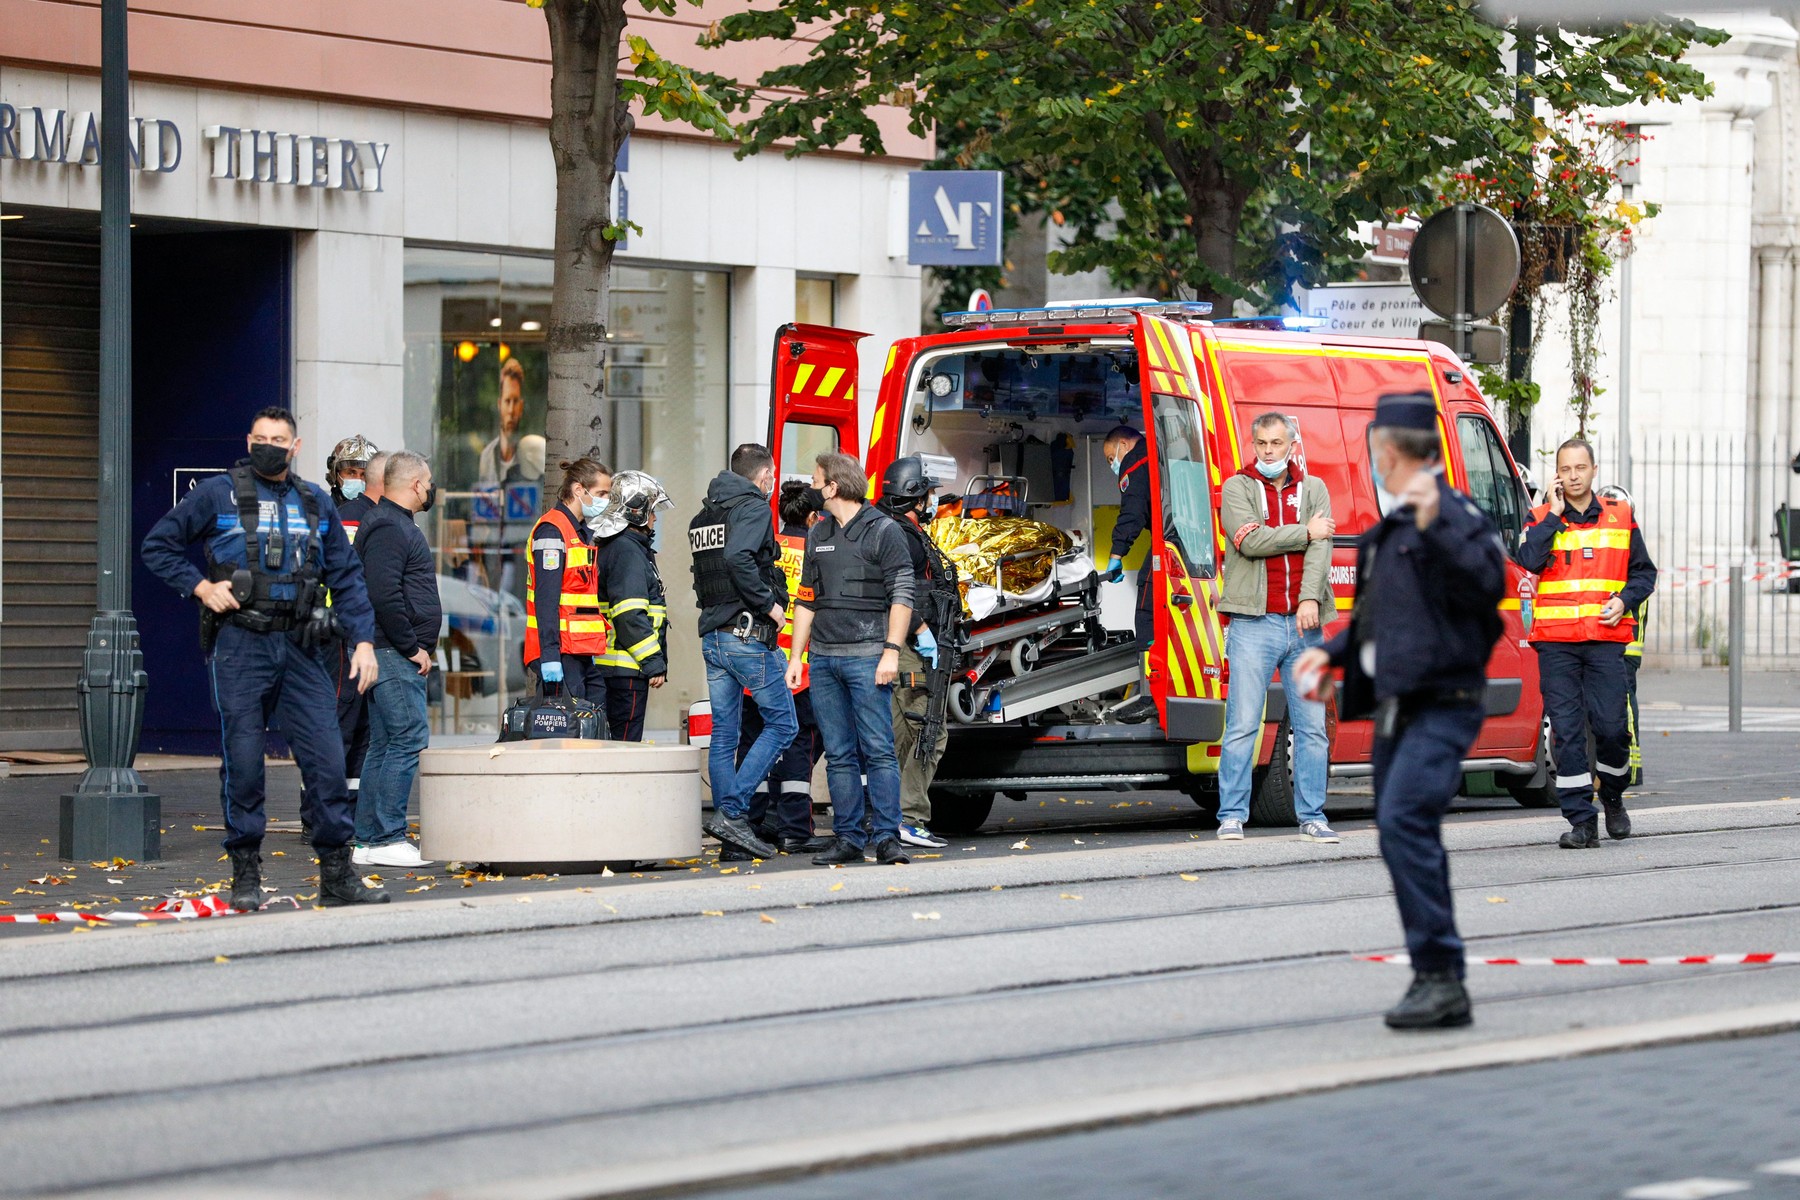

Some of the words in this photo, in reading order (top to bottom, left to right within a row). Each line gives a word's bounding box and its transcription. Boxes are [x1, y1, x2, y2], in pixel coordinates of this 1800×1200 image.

[207, 126, 390, 193] THIERY
[1331, 299, 1356, 311] Pôle
[1362, 299, 1376, 310] de
[1331, 319, 1366, 330] Coeur
[1371, 318, 1384, 329] de
[690, 527, 724, 549] POLICE
